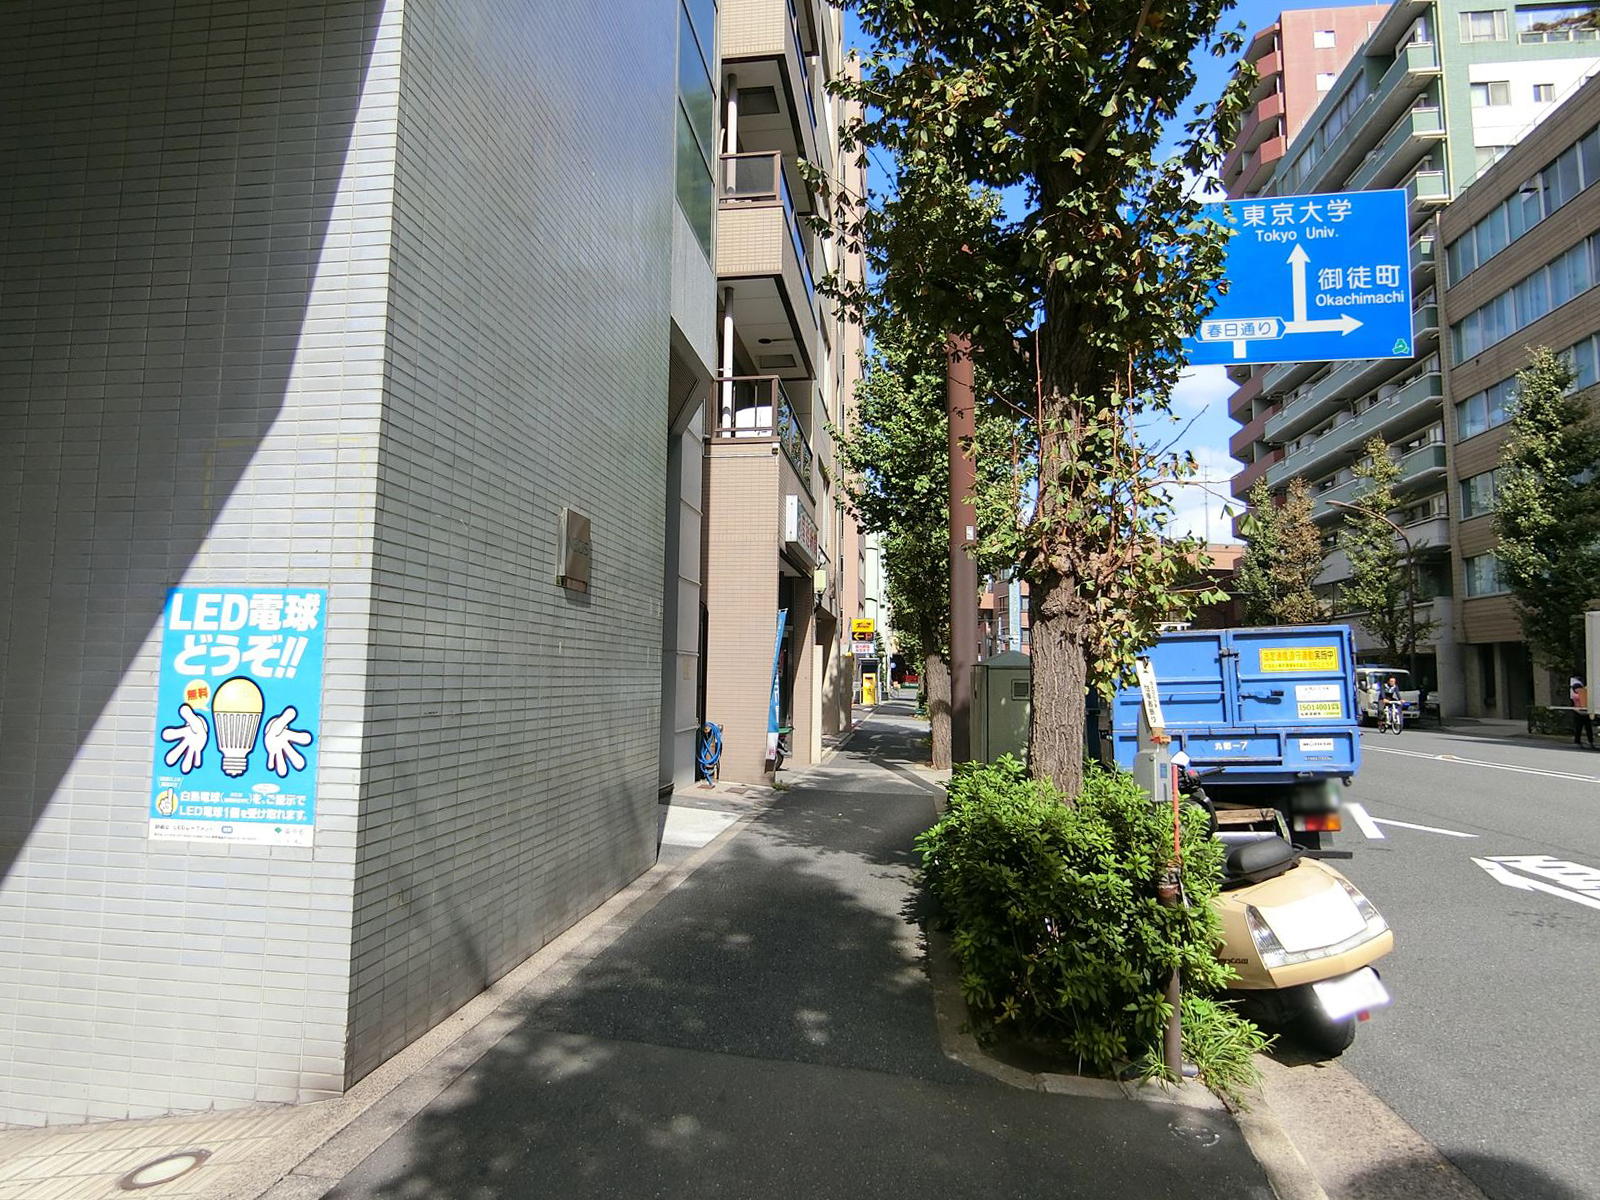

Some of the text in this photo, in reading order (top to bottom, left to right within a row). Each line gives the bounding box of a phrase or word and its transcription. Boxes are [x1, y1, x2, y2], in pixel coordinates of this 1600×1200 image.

[1242, 199, 1352, 227] 東京大学
[1255, 226, 1339, 243] Tokyo Univ.
[1318, 265, 1400, 290] 御徒町
[1316, 291, 1405, 307] Okachimachi
[1207, 321, 1271, 338] 春日通り
[169, 593, 321, 631] LED電球
[187, 687, 208, 700] 無料
